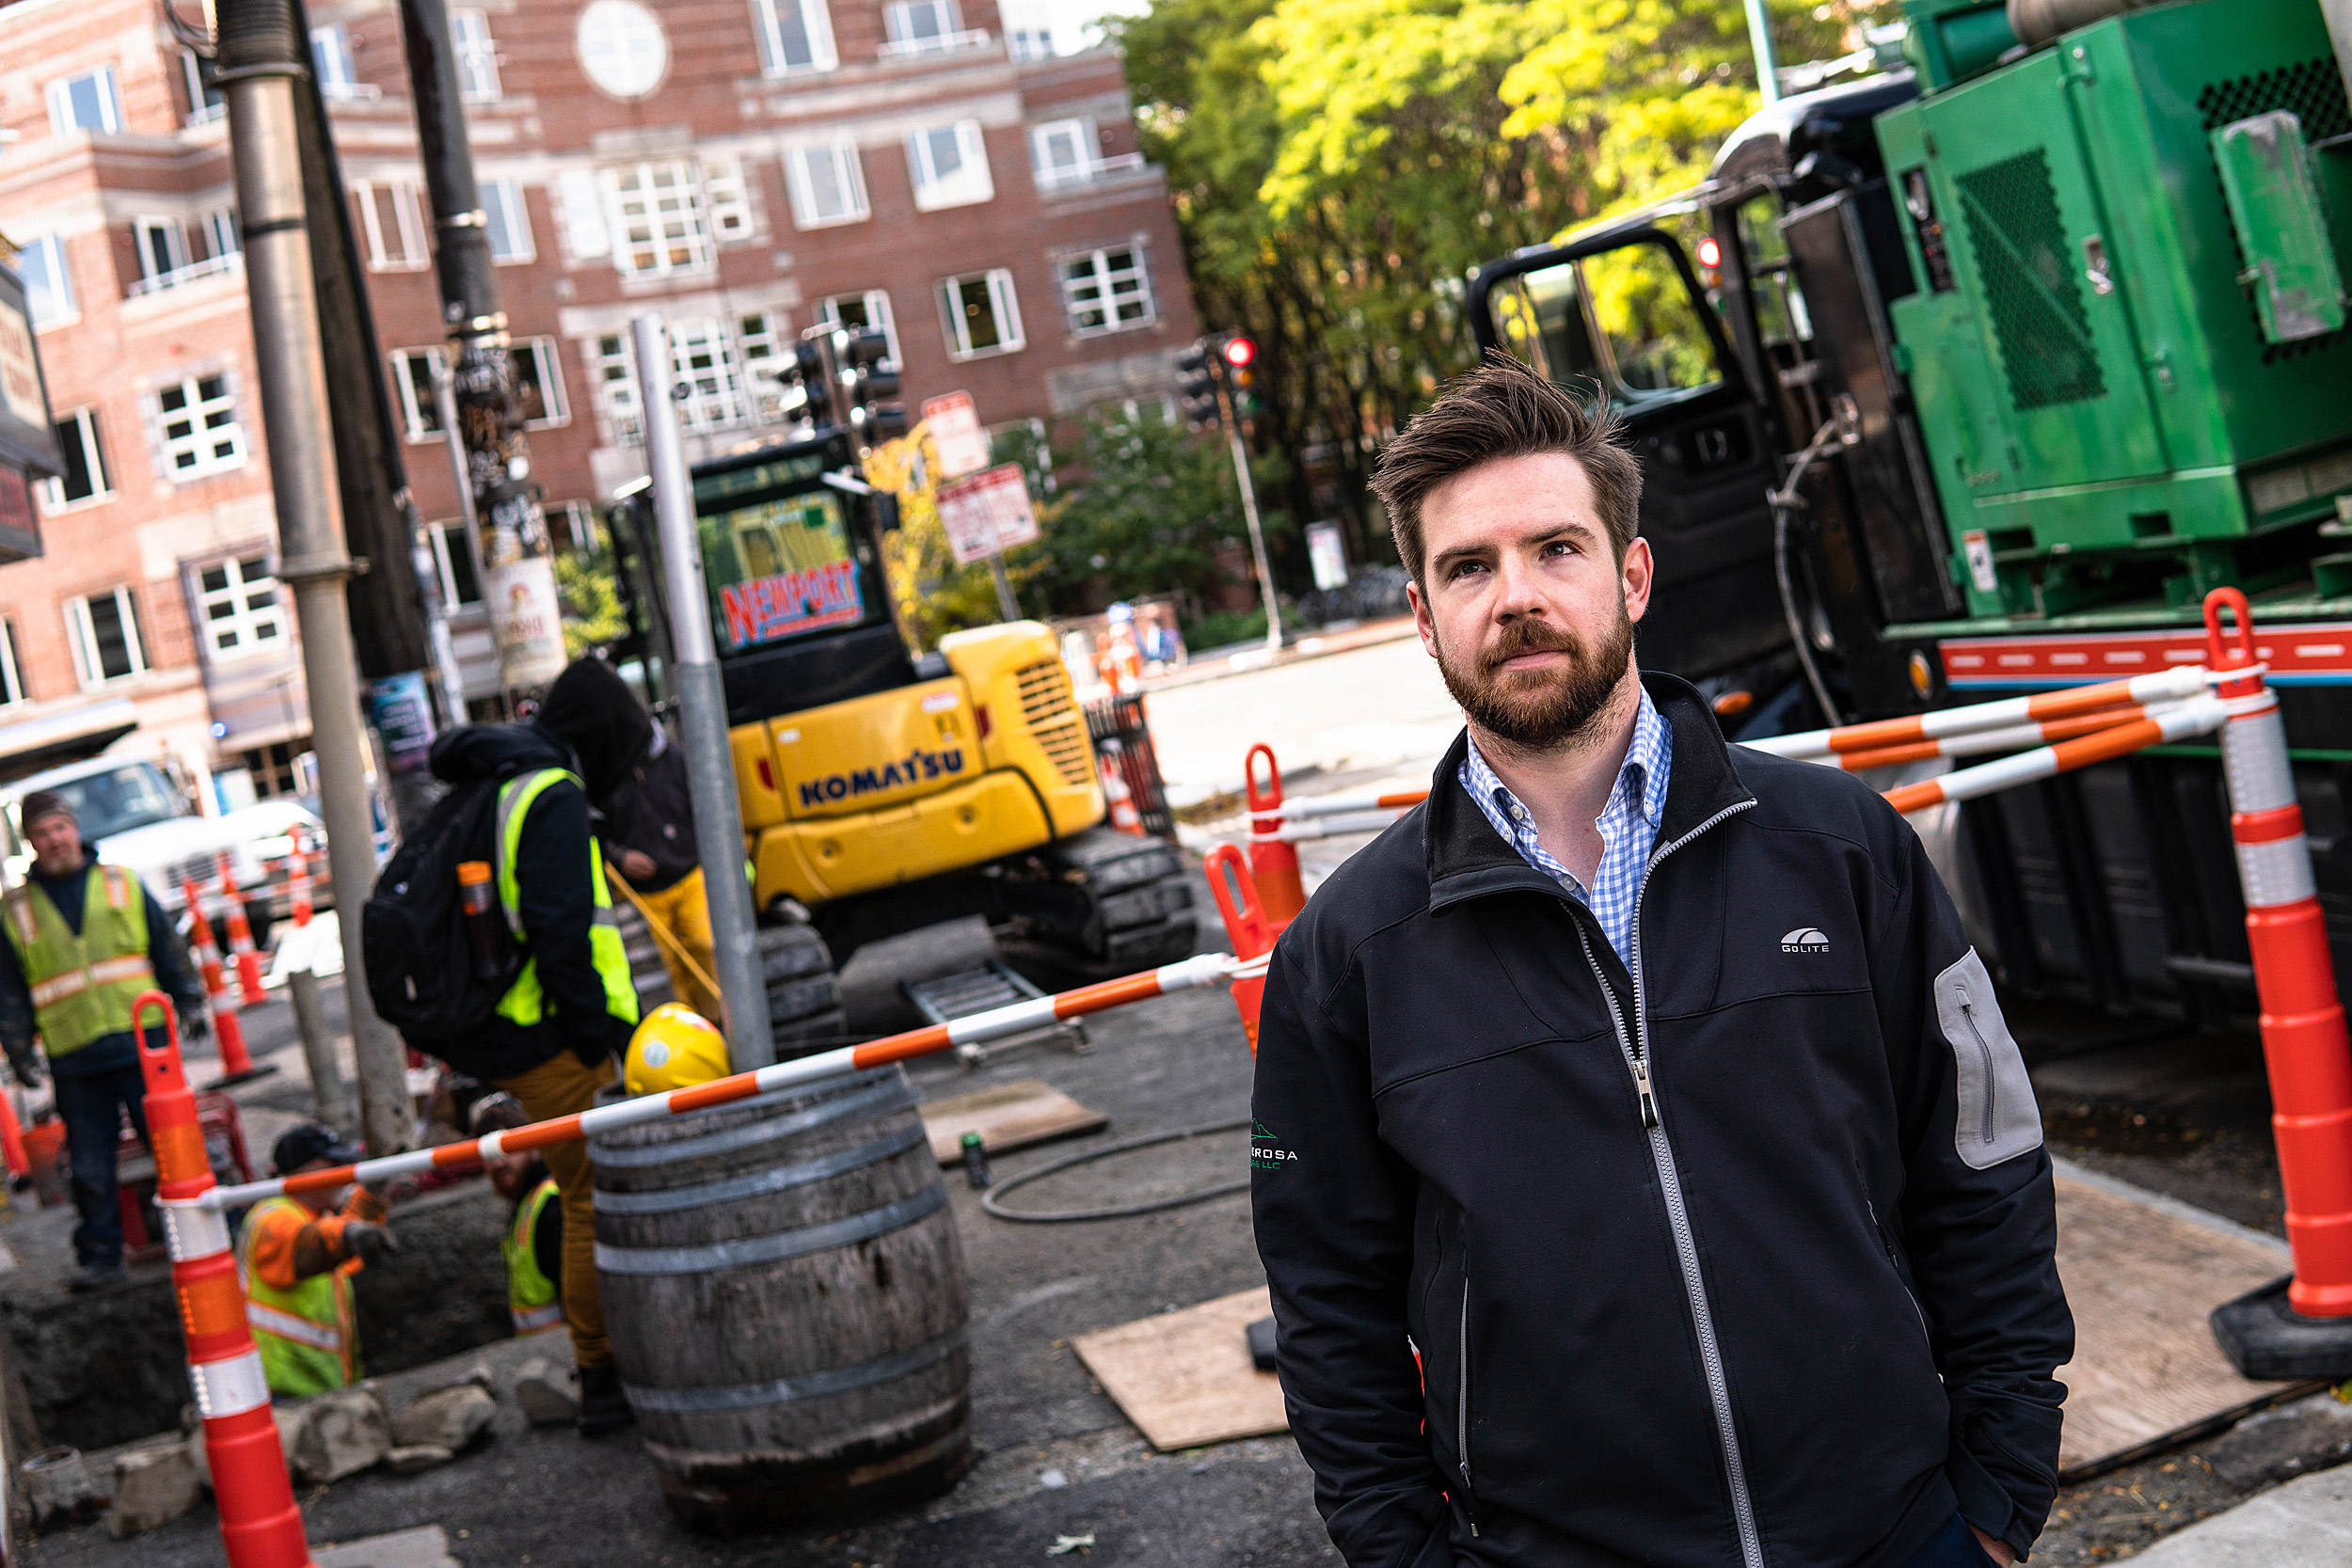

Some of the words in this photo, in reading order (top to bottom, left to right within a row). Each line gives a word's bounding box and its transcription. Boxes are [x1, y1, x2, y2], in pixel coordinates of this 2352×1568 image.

[719, 557, 864, 649] NEWPORT
[799, 749, 962, 808] KOMATSU
[1782, 944, 1830, 953] GOLITE
[1262, 1161, 1280, 1169] LLC
